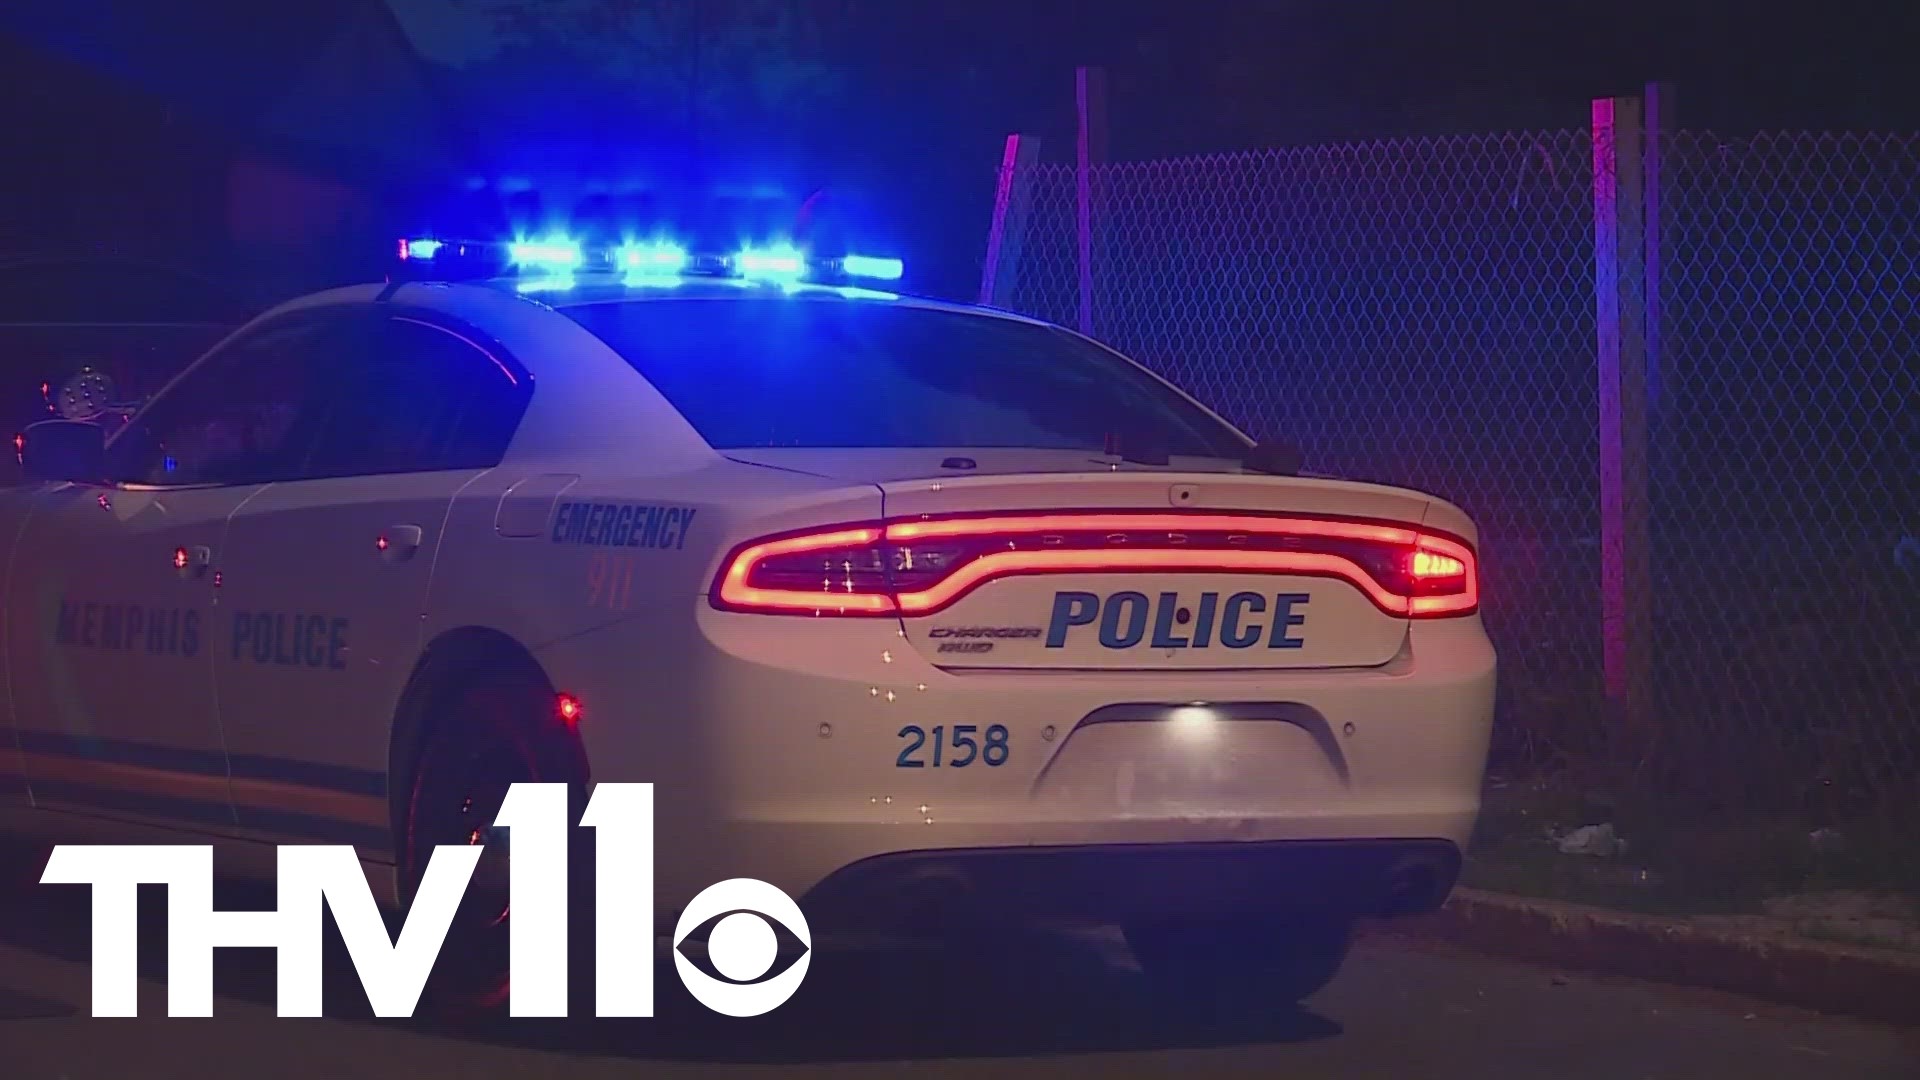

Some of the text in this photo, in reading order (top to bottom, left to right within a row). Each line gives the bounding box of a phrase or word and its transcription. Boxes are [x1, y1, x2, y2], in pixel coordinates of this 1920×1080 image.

[552, 502, 697, 550] EMERGENCY
[1042, 533, 1302, 547] DODGE
[587, 552, 633, 610] 911
[56, 600, 349, 669] MEMPHIS POLICE
[928, 627, 1042, 638] CHARGER
[1045, 591, 1311, 649] POLICE
[896, 724, 1010, 769] 2158
